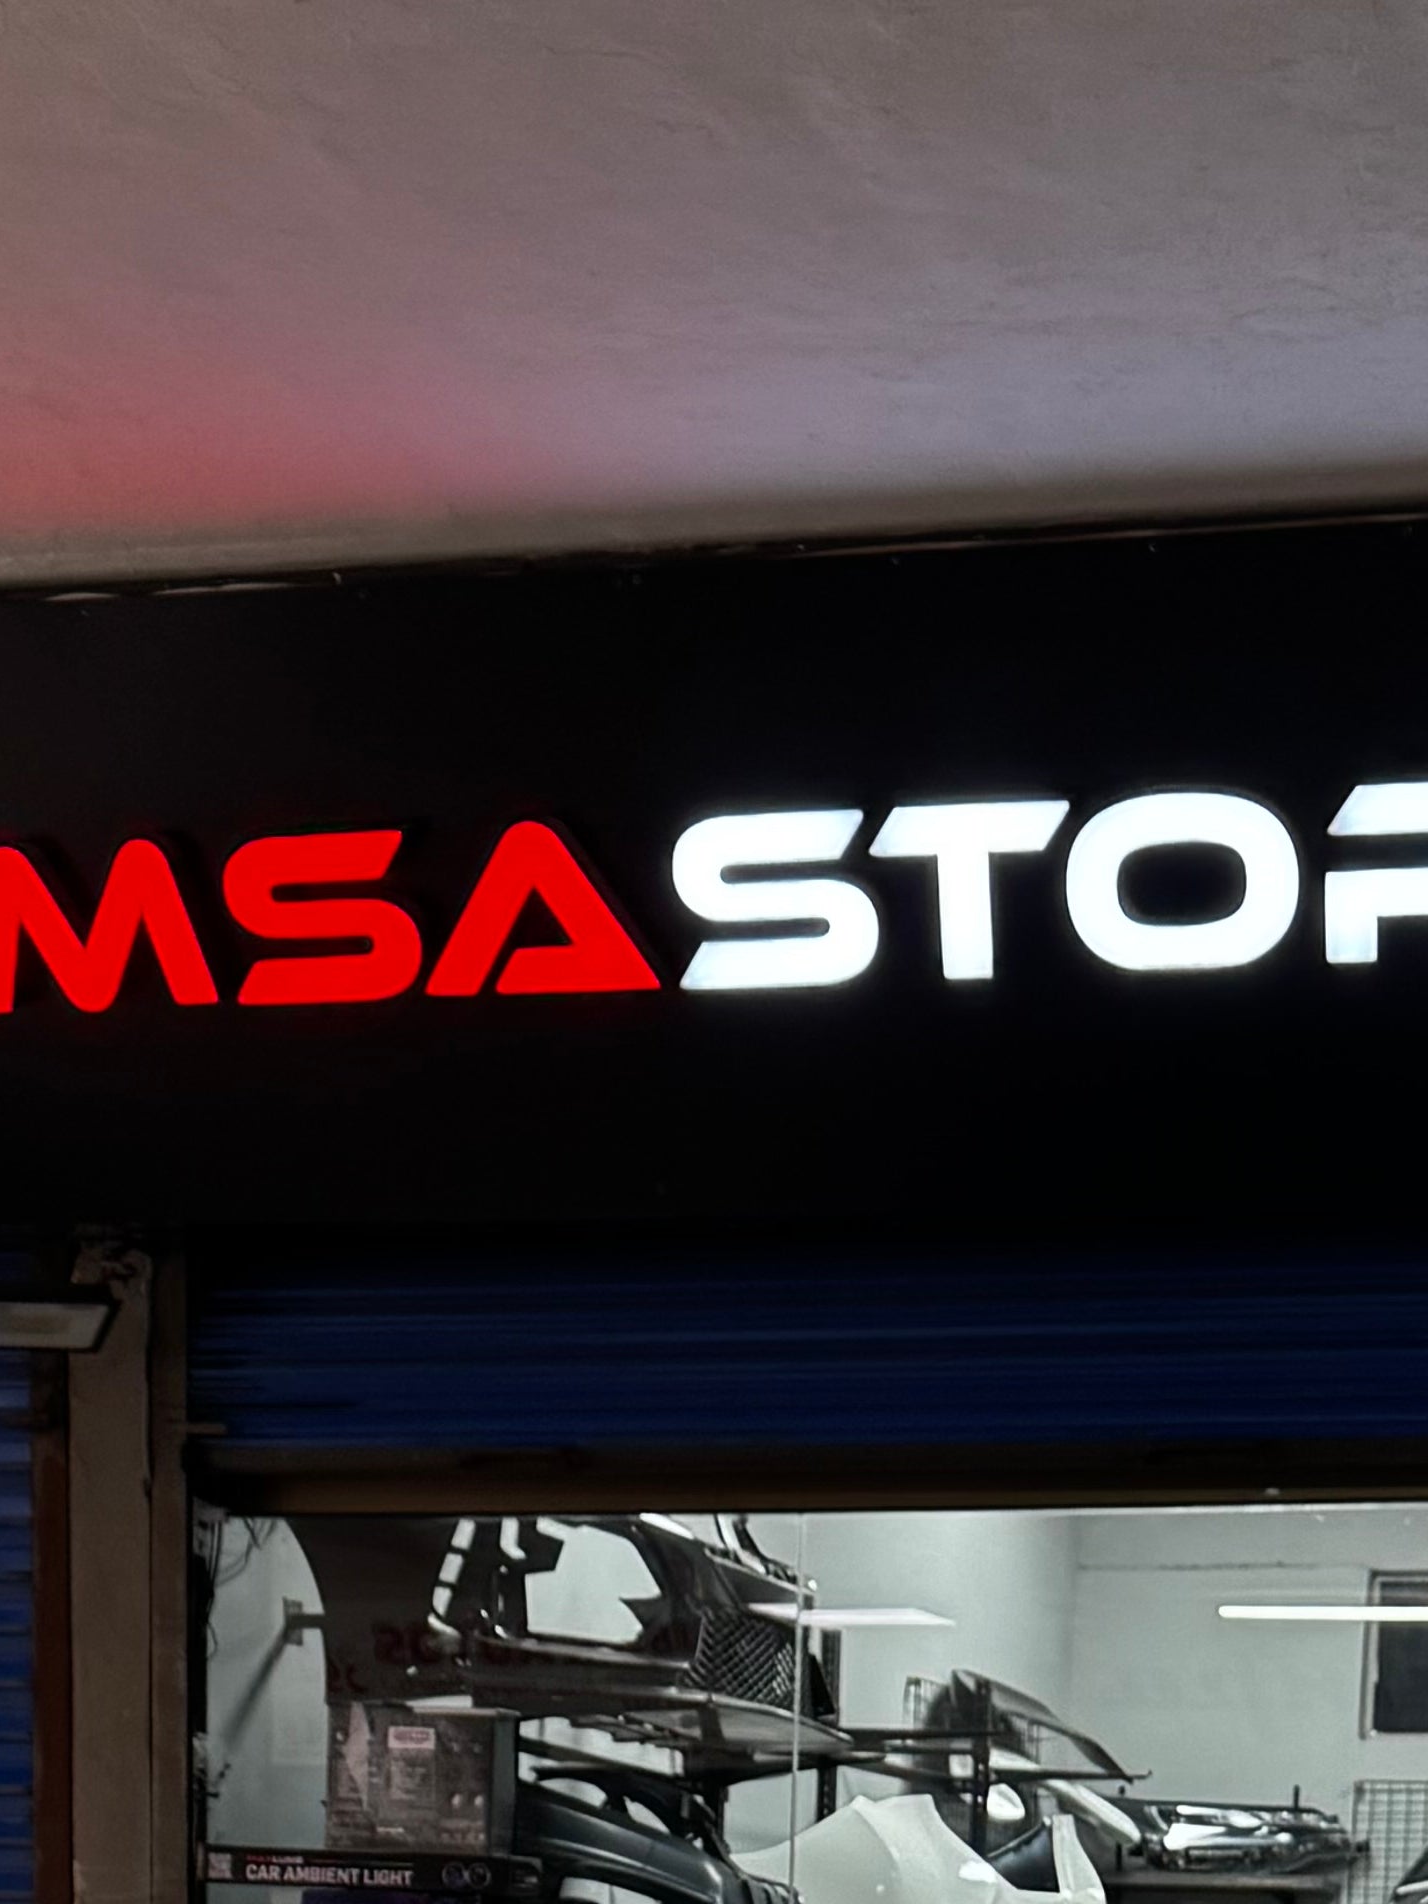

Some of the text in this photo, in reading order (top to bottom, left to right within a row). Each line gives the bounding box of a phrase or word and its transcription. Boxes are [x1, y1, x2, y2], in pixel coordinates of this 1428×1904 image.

[245, 1864, 414, 1887] CAR AMBIENT LIGHT
